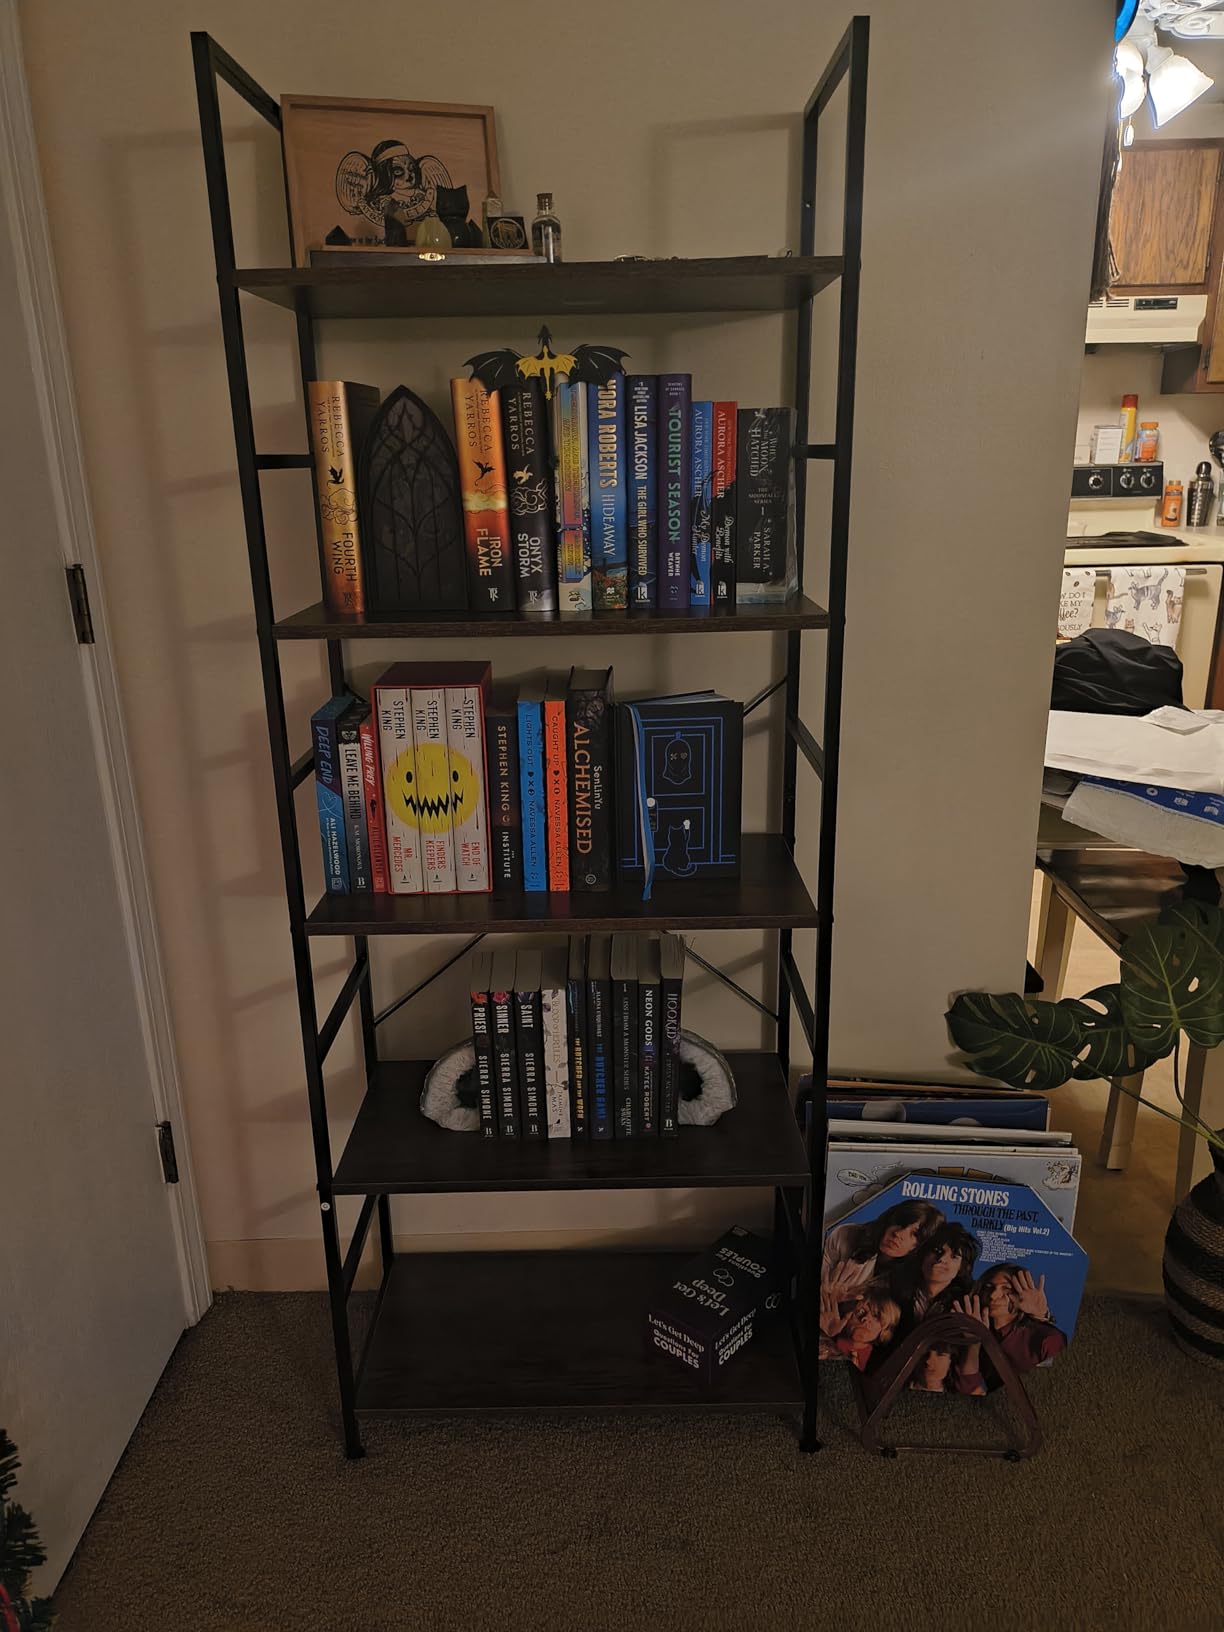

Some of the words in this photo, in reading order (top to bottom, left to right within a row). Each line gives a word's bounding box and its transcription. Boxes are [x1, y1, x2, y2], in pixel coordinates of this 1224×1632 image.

[316, 401, 330, 453] YARROS
[332, 396, 344, 458] REBECCA
[464, 395, 477, 448] YARROS
[480, 389, 491, 452] REBECCA
[508, 398, 520, 450] YARROS
[522, 392, 536, 455] REBECCA
[634, 405, 648, 429] LISA
[694, 408, 702, 454] AURORA
[717, 410, 726, 456] AURORA
[597, 426, 617, 489] ROBERTS
[634, 430, 648, 480] JACKSON
[668, 408, 682, 477] TOURIST
[750, 428, 760, 477] HATCHED
[760, 440, 769, 473] MOON
[768, 436, 777, 462] WHEN
[637, 485, 647, 500] THE
[694, 456, 702, 498] ASCHER
[717, 458, 726, 499] ASCHER
[600, 494, 616, 557] HIDEAWAY
[637, 501, 648, 518] GIRL
[668, 484, 682, 544] SEASON
[637, 519, 648, 538] WHO
[712, 526, 724, 560] Benefits
[724, 515, 734, 546] Demon
[763, 528, 771, 561] SARAH
[332, 541, 344, 575] WING
[342, 532, 357, 582] FOURTH
[476, 528, 492, 576] FLAME
[488, 536, 504, 567] IRON
[516, 533, 530, 578] STORM
[528, 536, 543, 574] ONYX
[637, 539, 648, 576] SURVIVED
[700, 532, 710, 562] Demon
[724, 547, 733, 564] with
[752, 531, 761, 570] PARKER
[382, 710, 393, 731] KING
[392, 700, 406, 740] STEPHEN
[416, 709, 426, 731] KING
[427, 700, 440, 740] STEPHEN
[452, 708, 462, 730] KING
[464, 699, 476, 738] STEPHEN
[525, 714, 534, 746] LIGHTS
[316, 726, 332, 760] DEEP
[362, 733, 374, 763] WILLING
[496, 725, 508, 777] STEPHEN
[320, 760, 332, 785] END
[344, 748, 358, 773] LEAVE
[365, 764, 376, 786] PREY
[552, 754, 559, 766] UP
[347, 774, 358, 790] ME
[500, 782, 510, 812] KING
[573, 723, 592, 854] ALCHEMISED
[593, 765, 602, 810] SenLinYu
[348, 790, 362, 820] BEHIND
[528, 800, 536, 839] NAVESSA
[331, 830, 341, 876] HAZELWOOD
[392, 836, 404, 873] MERCEDES
[403, 847, 412, 862] MR.
[426, 840, 436, 872] KEEPERS
[436, 840, 446, 870] FINDERS
[462, 842, 471, 866] WATCH
[472, 842, 480, 856] END
[472, 858, 481, 866] OF
[502, 831, 511, 879] INSTITUTE
[496, 1005, 510, 1034] SINNER
[521, 1004, 534, 1029] SAINT
[551, 1000, 560, 1024] BLOOD
[645, 990, 654, 1017] NEON
[474, 1007, 487, 1035] PRIEST
[644, 1020, 654, 1046] GODS
[478, 1056, 490, 1086] SIERRA
[500, 1053, 511, 1084] SIERRA
[525, 1052, 536, 1084] SIERRA
[574, 1046, 583, 1080] BUTCHER
[594, 1055, 606, 1095] BUTCHER
[480, 1088, 492, 1120] SIMONE
[502, 1087, 513, 1118] SIMONE
[527, 1086, 538, 1118] SIMONE
[576, 1098, 584, 1120] WREN
[902, 1180, 959, 1202] ROLLING
[959, 1186, 1010, 1206] STONES
[953, 1203, 996, 1218] THROUGH
[996, 1207, 1015, 1219] THE
[1014, 1209, 1040, 1224] PAST,
[971, 1216, 1006, 1230] DARKLY
[720, 1246, 768, 1275] COUPLES
[726, 1258, 762, 1279] Questions
[672, 1280, 698, 1298] Get
[692, 1278, 727, 1301] Deep
[697, 1294, 730, 1317] Let's
[648, 1312, 667, 1332] Let's
[668, 1324, 683, 1340] Get
[683, 1332, 705, 1354] Deep
[654, 1328, 687, 1352] Questions
[714, 1331, 730, 1351] Let's
[718, 1330, 753, 1366] COUPLES
[654, 1337, 700, 1369] COUPLES
